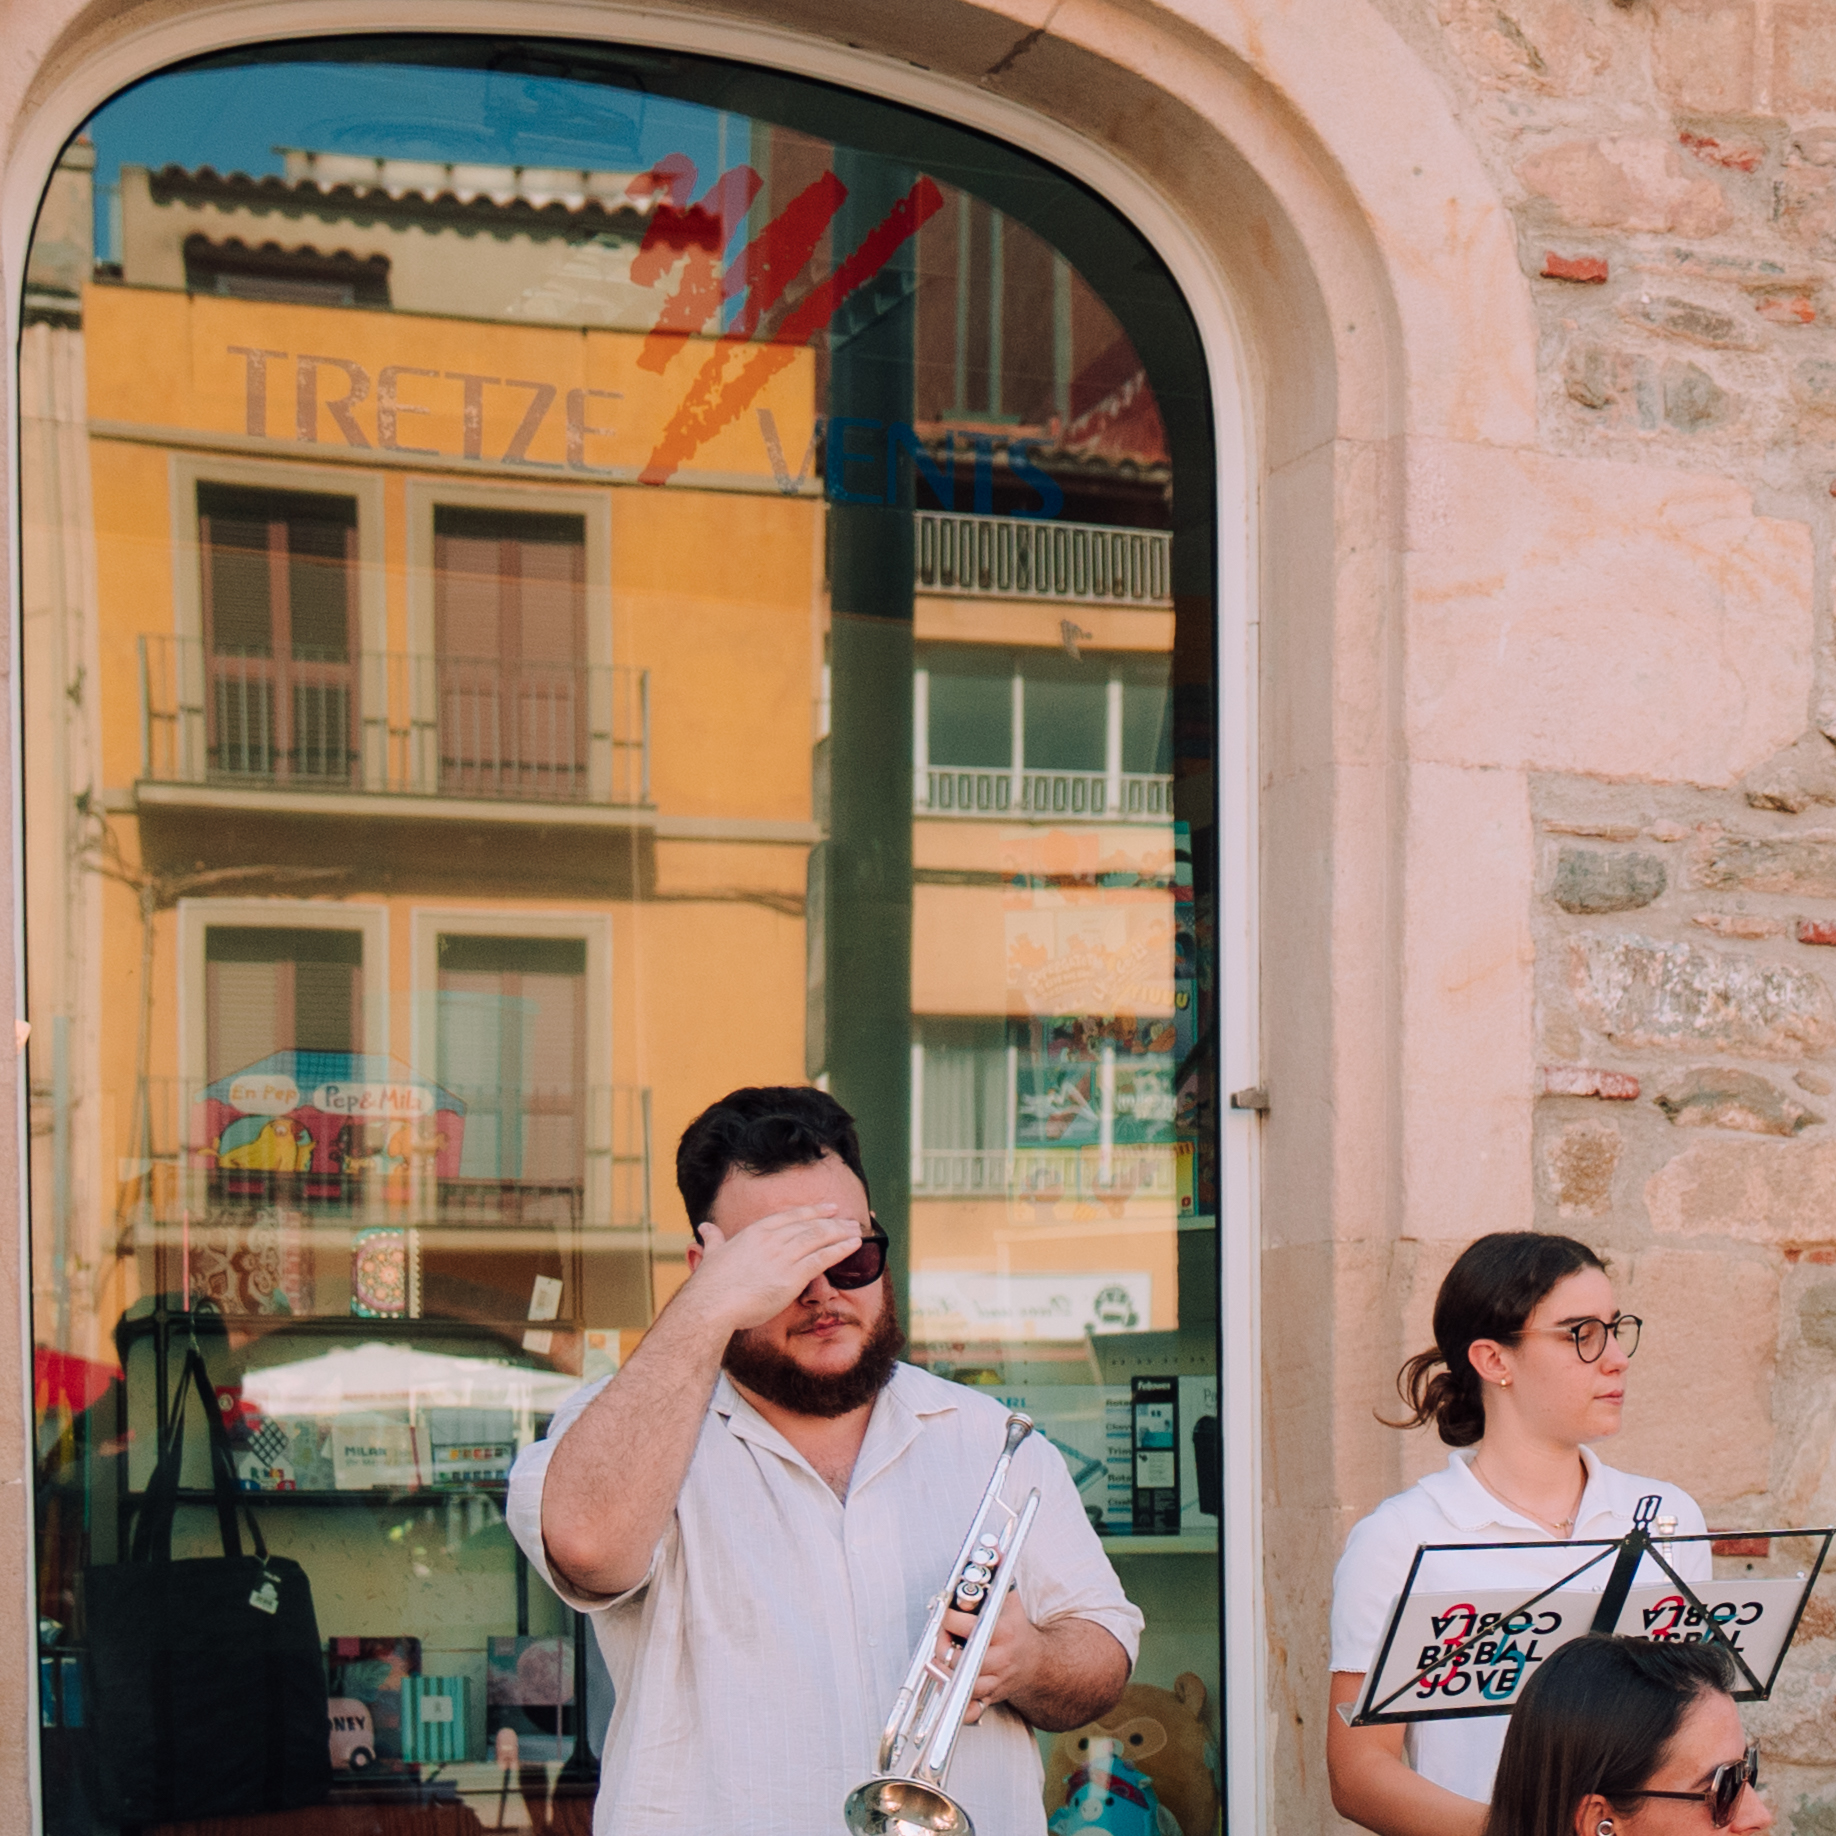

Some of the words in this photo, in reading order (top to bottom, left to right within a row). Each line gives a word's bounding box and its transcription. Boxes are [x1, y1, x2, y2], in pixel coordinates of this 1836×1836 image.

[227, 345, 625, 477] TRETZE
[756, 408, 1064, 520] VENTS
[263, 1085, 297, 1104] Pep
[1418, 1639, 1543, 1669] BISBAL
[1416, 1667, 1520, 1698] JOVE
